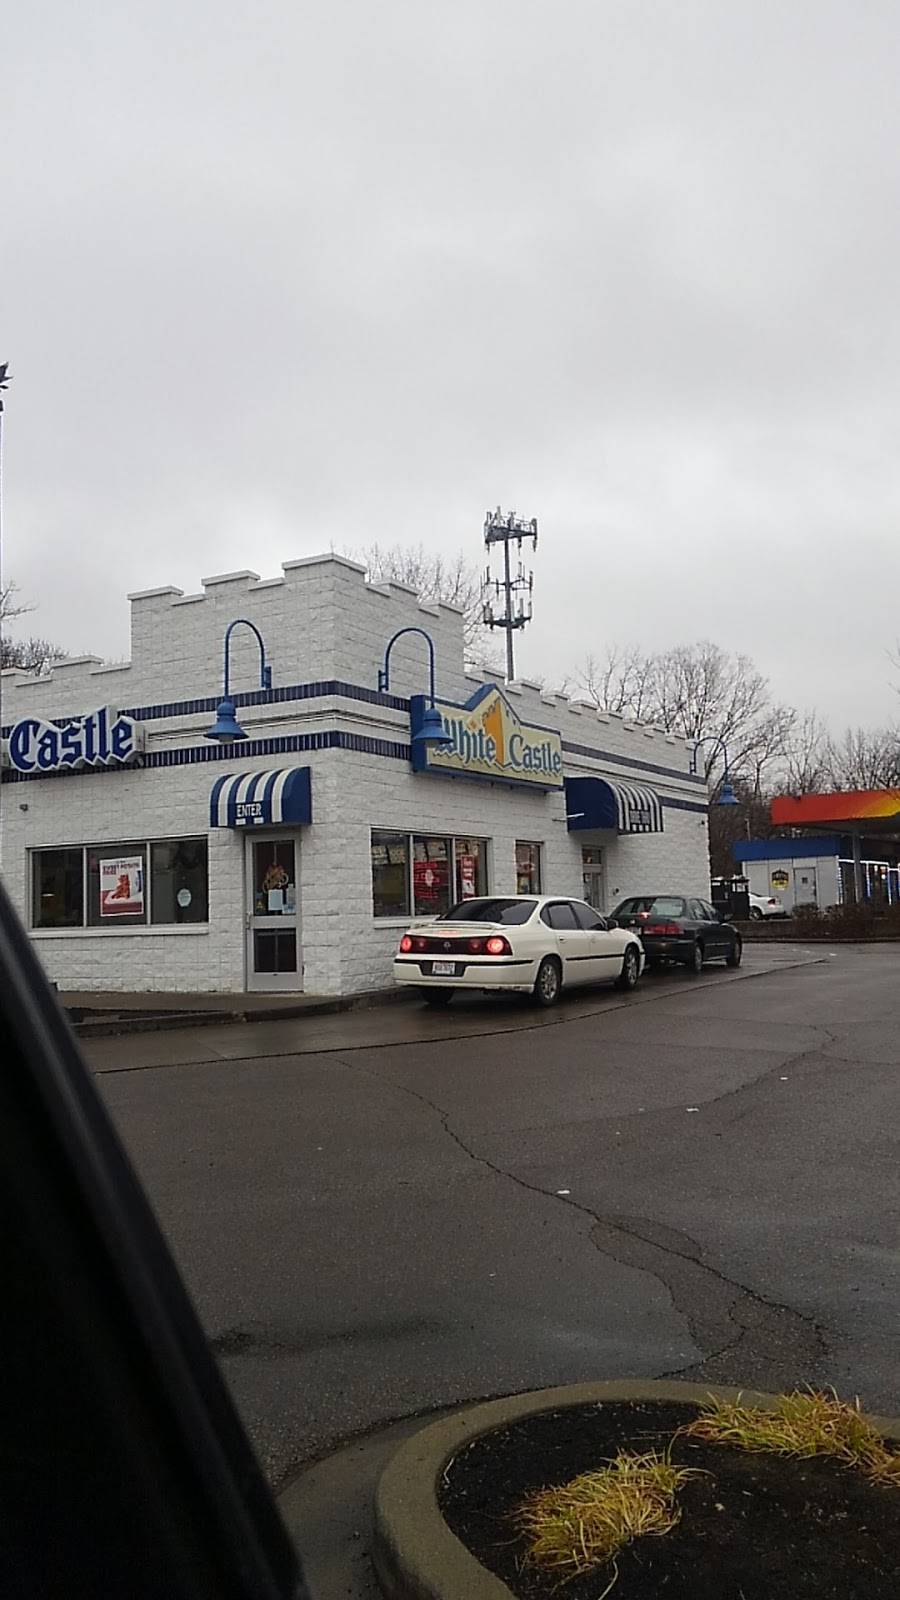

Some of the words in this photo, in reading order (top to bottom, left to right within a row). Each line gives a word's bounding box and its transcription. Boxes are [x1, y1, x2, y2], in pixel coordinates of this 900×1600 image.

[9, 705, 134, 771] Castle
[509, 734, 561, 773] Castle
[236, 803, 262, 818] ENTER
